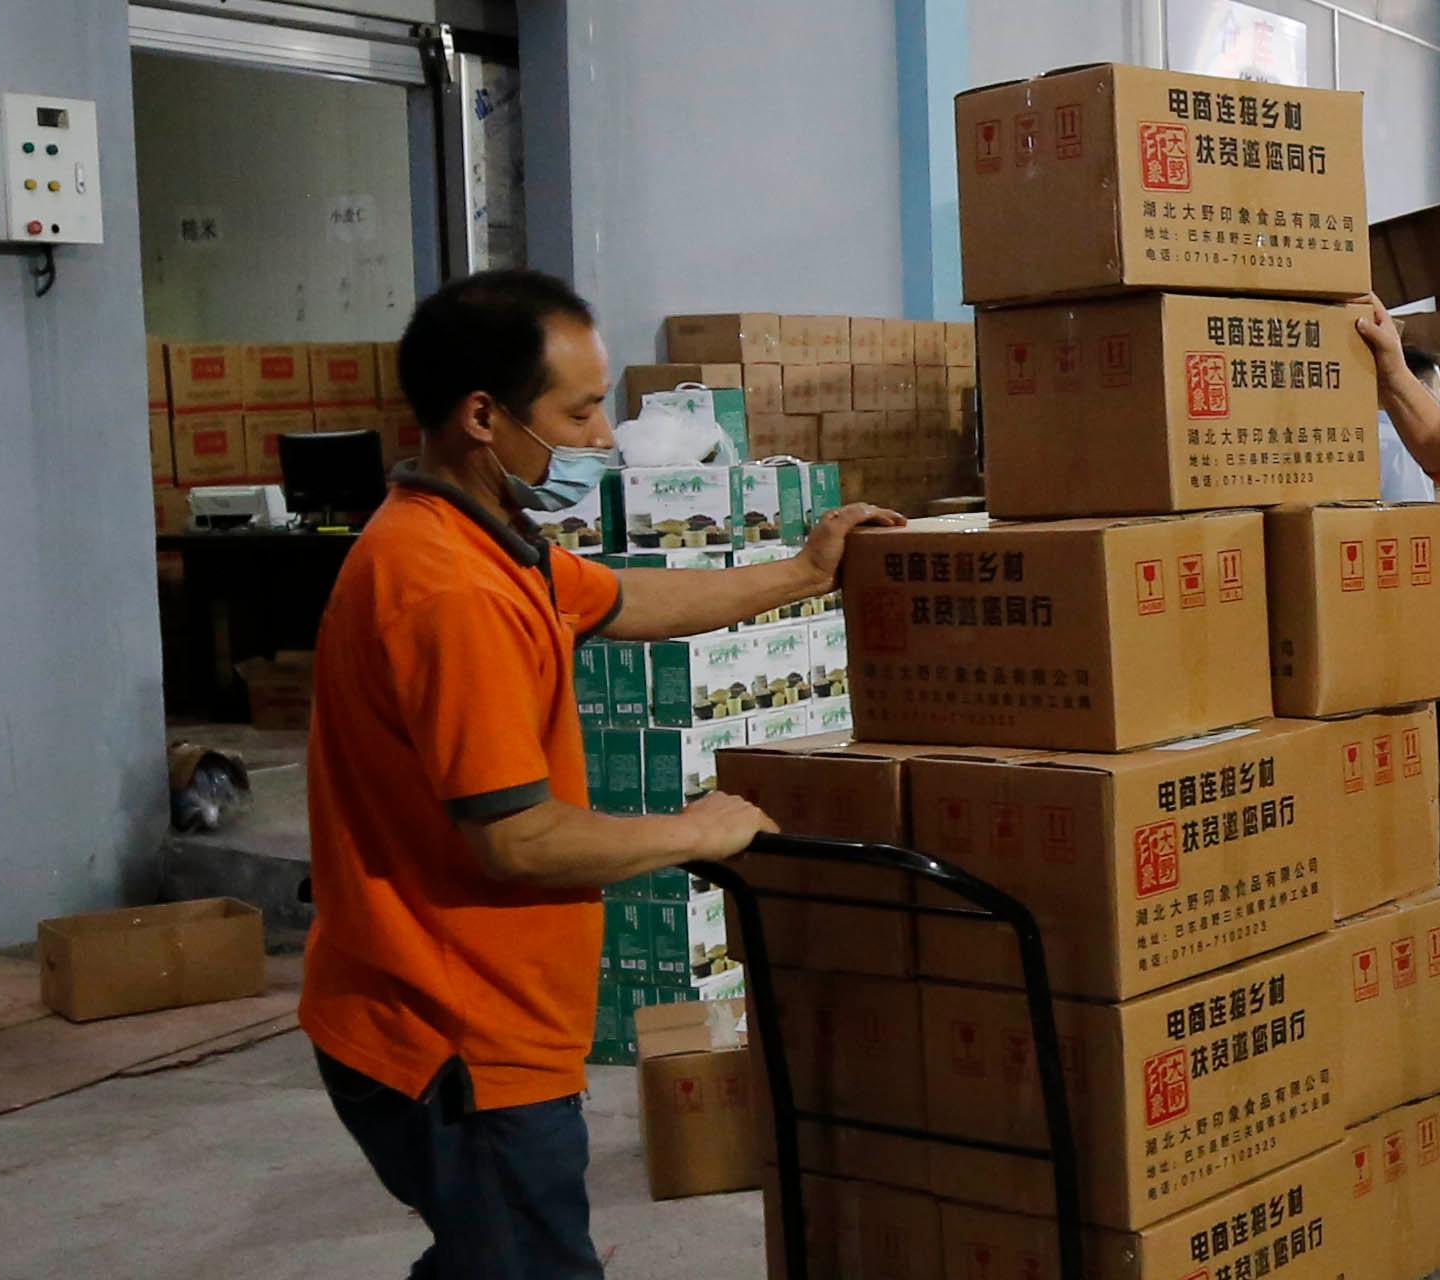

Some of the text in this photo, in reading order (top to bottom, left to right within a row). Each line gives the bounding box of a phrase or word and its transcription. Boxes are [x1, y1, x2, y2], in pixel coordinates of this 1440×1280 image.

[1168, 88, 1303, 131] 电商连接乡村
[1195, 133, 1327, 174] 扶贫邀您同行
[1143, 200, 1354, 233] 湖北大野印象食品有限公司
[1207, 315, 1321, 349] 电商连接乡村
[1230, 359, 1340, 390] 扶贫邀您同行
[1187, 427, 1366, 446] 湖北大野印象食品有限公司
[1157, 756, 1275, 813] 电商连接乡村
[1181, 795, 1295, 854] 扶贫邀您同行
[1135, 856, 1319, 928] 湖北大野印象食品有限公司
[1166, 973, 1285, 1042] 电商连接乡村
[1190, 1009, 1305, 1080] 扶贫邀您同行
[1191, 1184, 1304, 1263] 电商连接乡村
